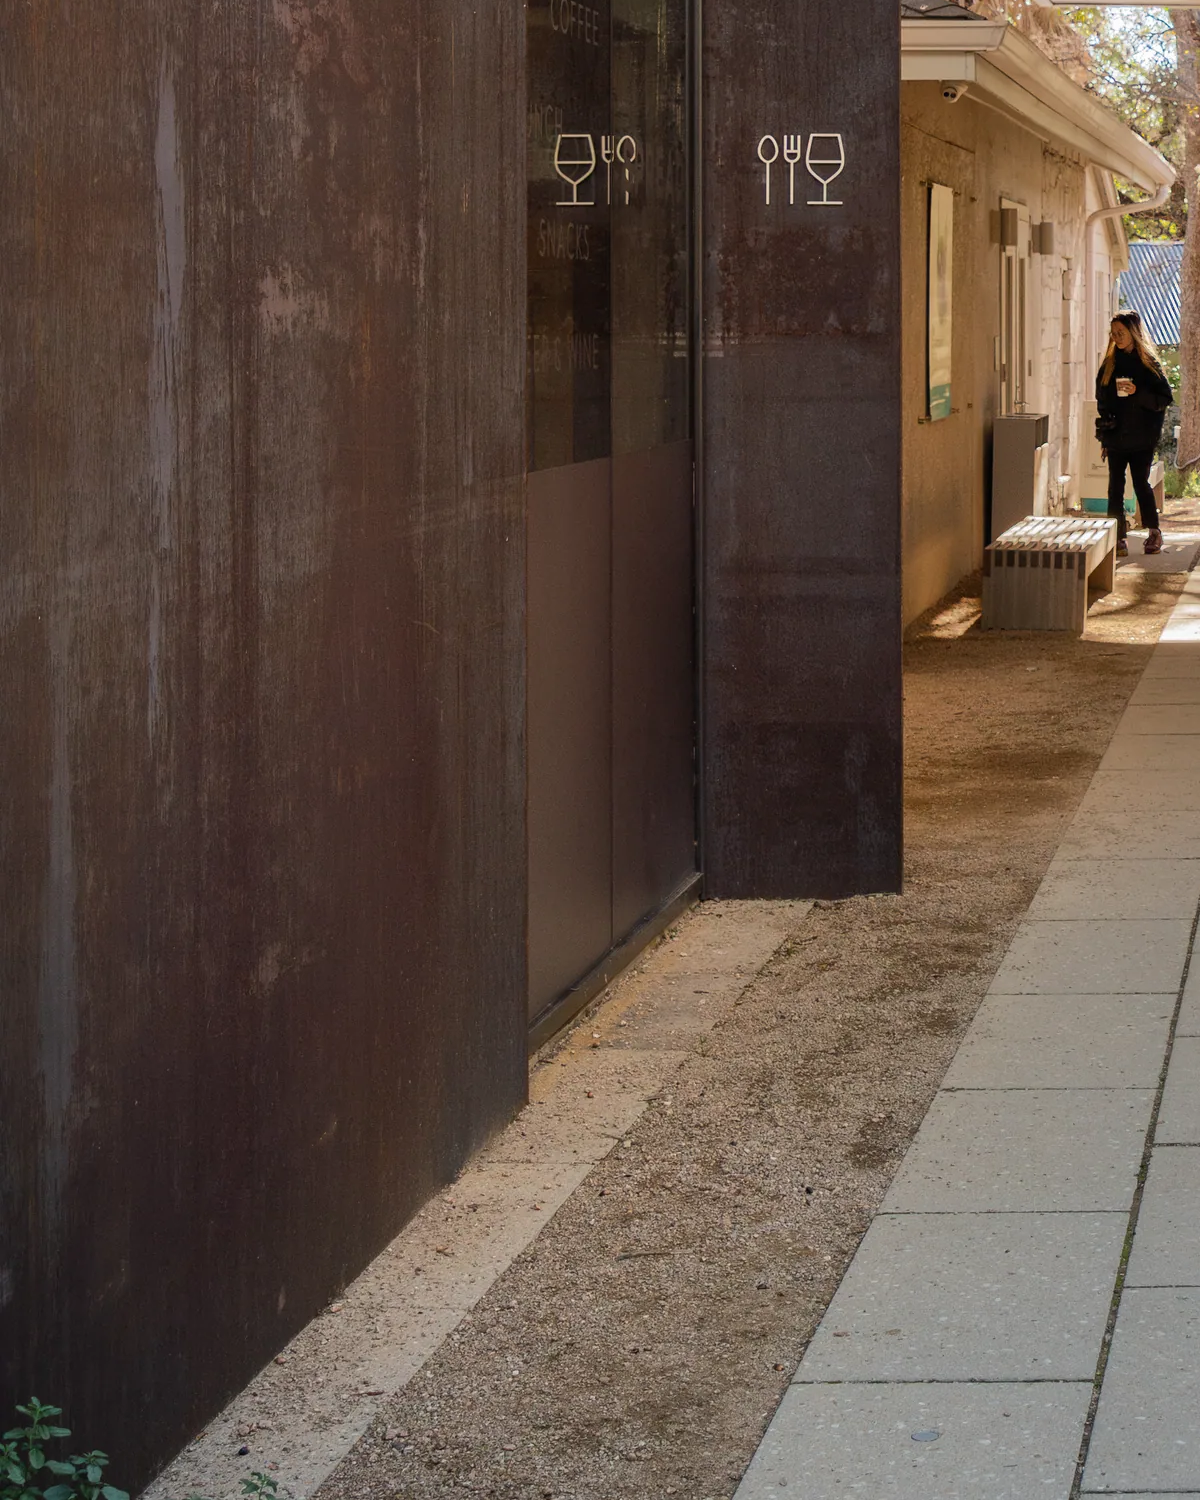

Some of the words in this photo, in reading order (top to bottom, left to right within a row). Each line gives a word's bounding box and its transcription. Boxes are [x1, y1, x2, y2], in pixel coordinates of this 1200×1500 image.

[526, 103, 563, 145] UNCH
[536, 217, 590, 261] SNACKS
[568, 333, 600, 370] WINE
